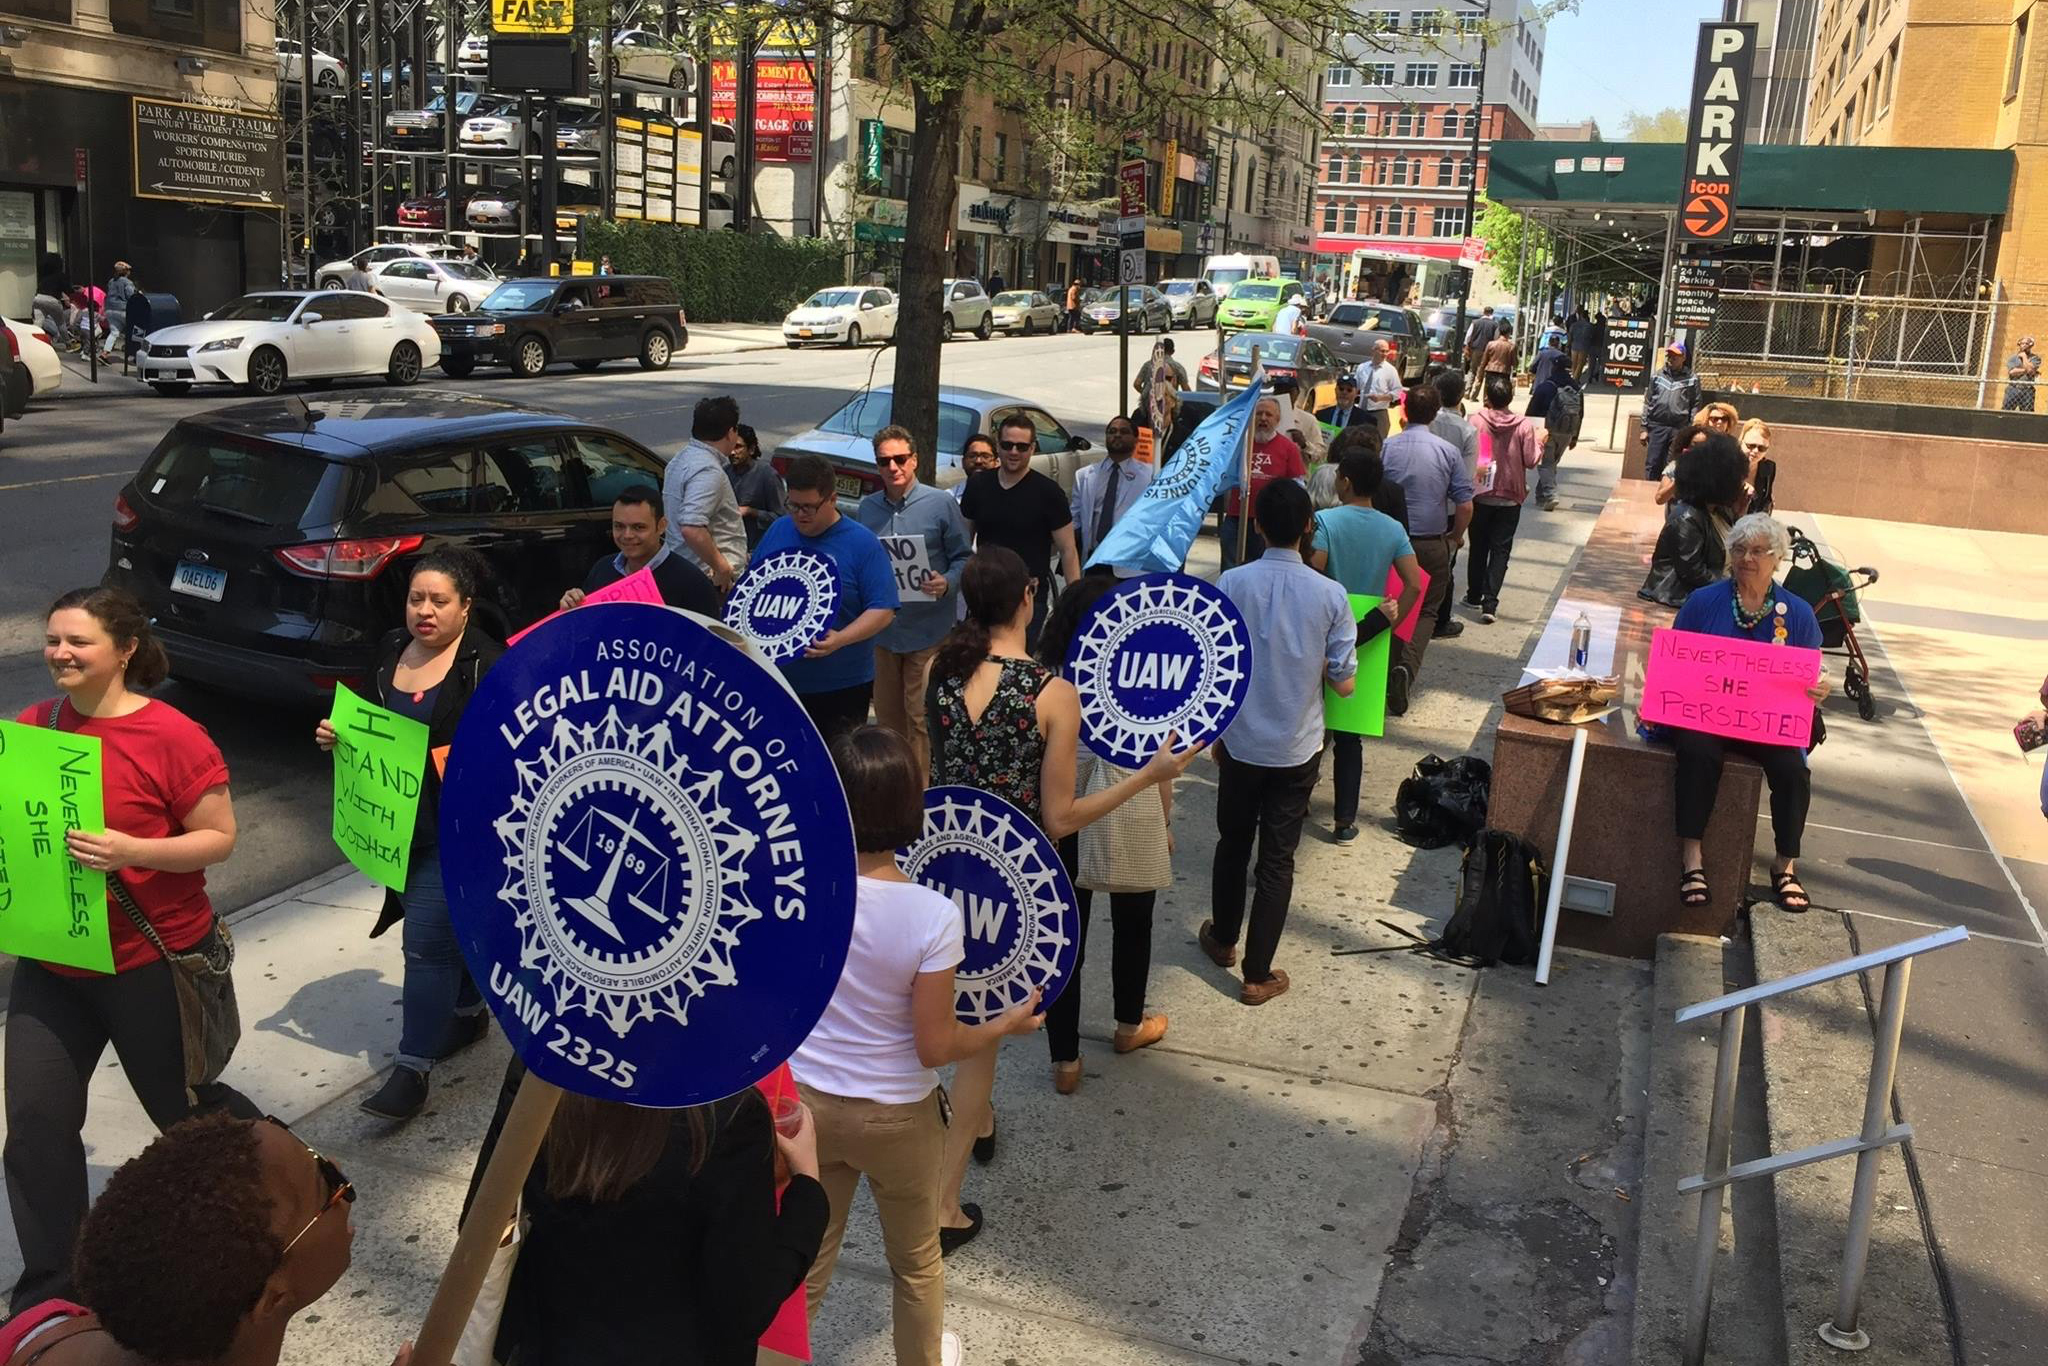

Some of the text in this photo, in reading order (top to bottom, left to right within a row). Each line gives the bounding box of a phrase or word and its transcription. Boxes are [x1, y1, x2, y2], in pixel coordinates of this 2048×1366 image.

[1695, 28, 1745, 177] PARK
[138, 104, 172, 120] PARK
[177, 111, 226, 127] AVENUE
[157, 118, 184, 129] INJURY
[188, 122, 232, 135] TREATMENT
[175, 146, 248, 163] SPORTS INJURIES
[200, 135, 268, 152] COMPENSATION
[158, 157, 218, 172] AUTOMOBILE
[1690, 179, 1730, 194] icon
[1679, 276, 1715, 286] Parking
[1680, 267, 1692, 276] 24
[1677, 290, 1714, 298] monthly
[1675, 305, 1716, 314] available
[1609, 329, 1646, 339] special
[1607, 343, 1643, 361] 10 87
[1604, 367, 1641, 377] half hour
[880, 537, 916, 561] NO
[753, 593, 804, 620] UAW
[1132, 612, 1148, 622] AND
[1149, 608, 1196, 625] AGRICULTURAL
[1103, 621, 1130, 653] AEROSPACE
[1195, 622, 1215, 656] IMPLEMENT
[1117, 651, 1194, 691] UAW
[1660, 636, 1815, 681] NEVERTHELESS
[1204, 659, 1215, 693] WORKERS
[1705, 675, 1749, 698] SHE
[596, 639, 798, 775] ASSOCIATION OF
[1169, 705, 1197, 727] AMERICA
[348, 707, 396, 741] I
[335, 734, 419, 799] STAND
[341, 770, 395, 831] WITH
[499, 667, 806, 922] LEGAL AID ATTORNEYS
[25, 800, 51, 859] SHE
[335, 798, 402, 869] SOPHIA
[595, 833, 646, 875] 19 69
[528, 757, 715, 988] INTERNATIONAL UNION UNITED AUTOMOBILE AEROSPACE AND AGRICULTURAL IMPLEMENT WORKERS OF AMERICA UAW
[904, 832, 1036, 986] AEROSPACE AND AGRICULTURAL IMPLEMENT WORKERS OF AMERICA
[489, 961, 638, 1089] UAW 2325
